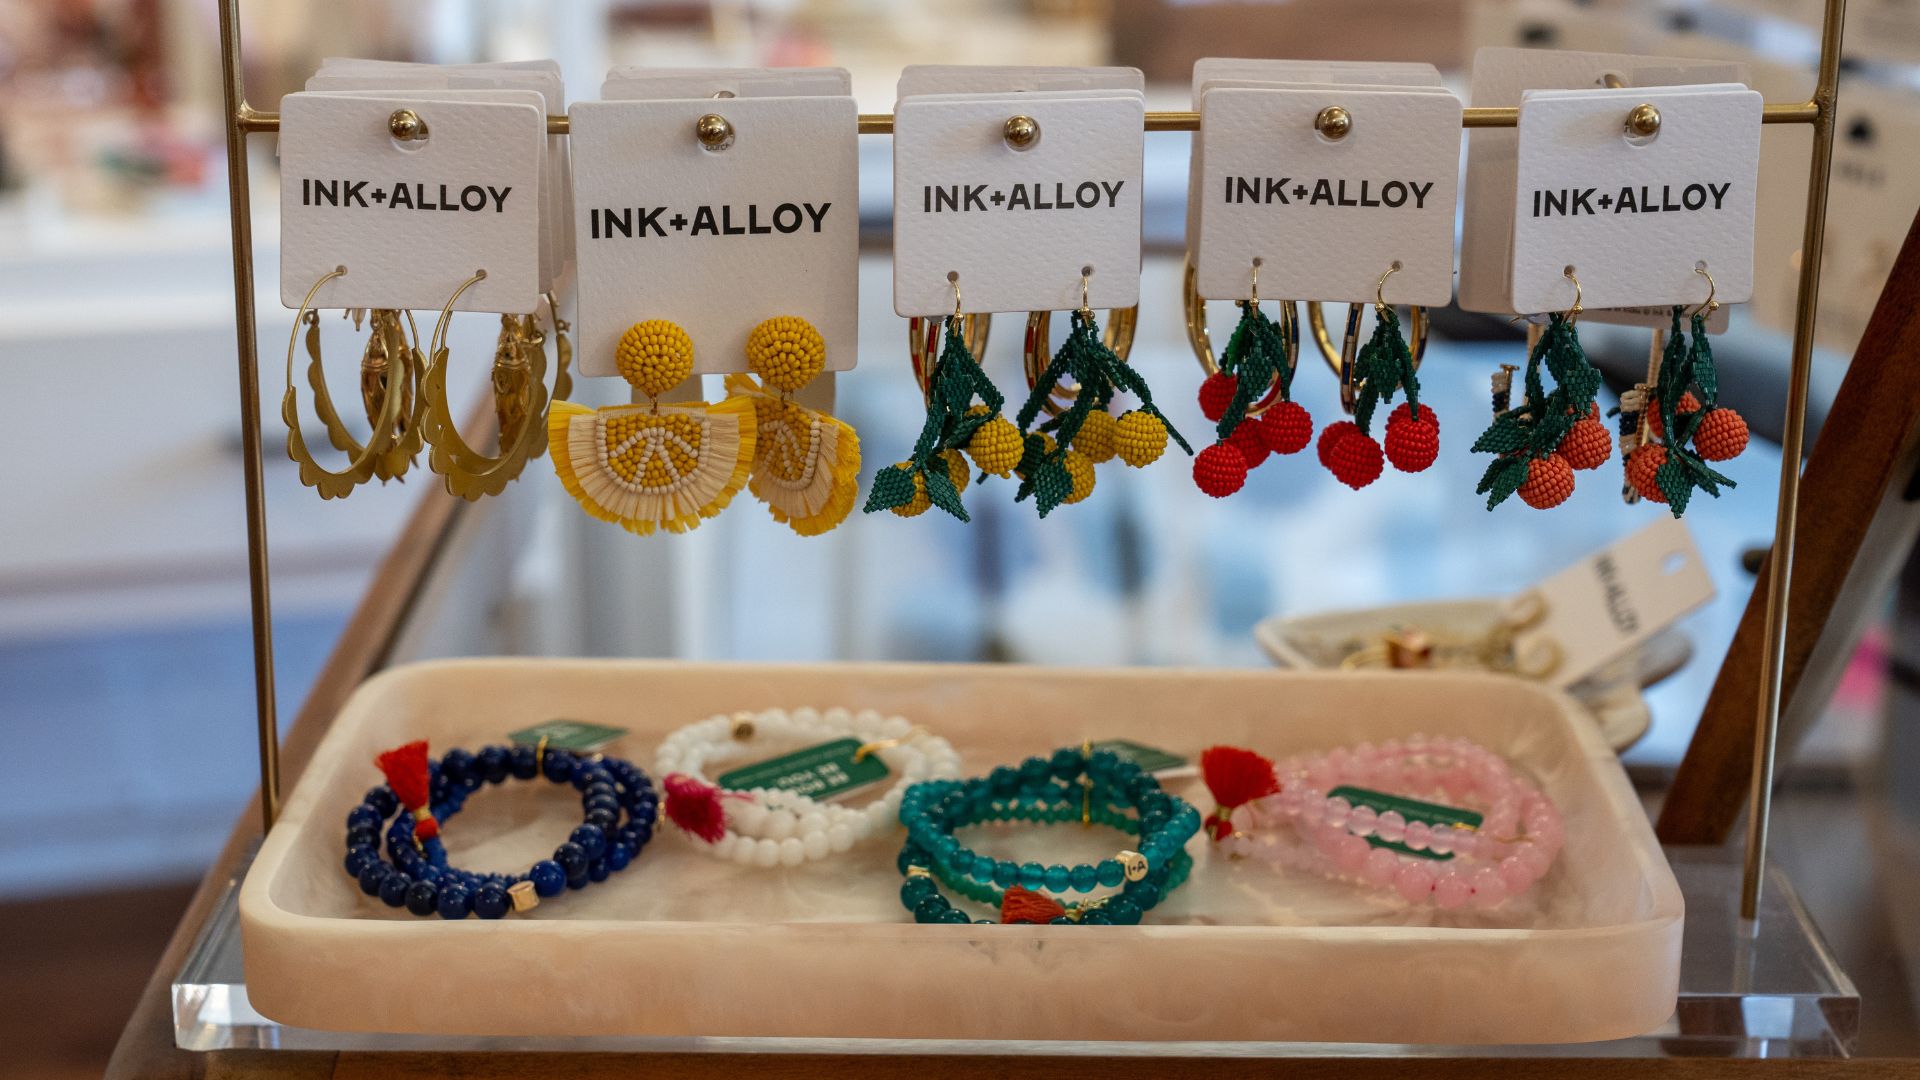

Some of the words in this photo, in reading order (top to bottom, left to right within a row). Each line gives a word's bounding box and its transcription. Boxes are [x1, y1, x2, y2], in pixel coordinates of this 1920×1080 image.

[303, 178, 513, 213] INK+ALLOY
[925, 180, 1125, 213] INK+ALLOY
[1226, 176, 1434, 209] INK+ALLOY
[1534, 183, 1731, 218] INK+ALLOY
[591, 202, 833, 240] INK+ALLOY
